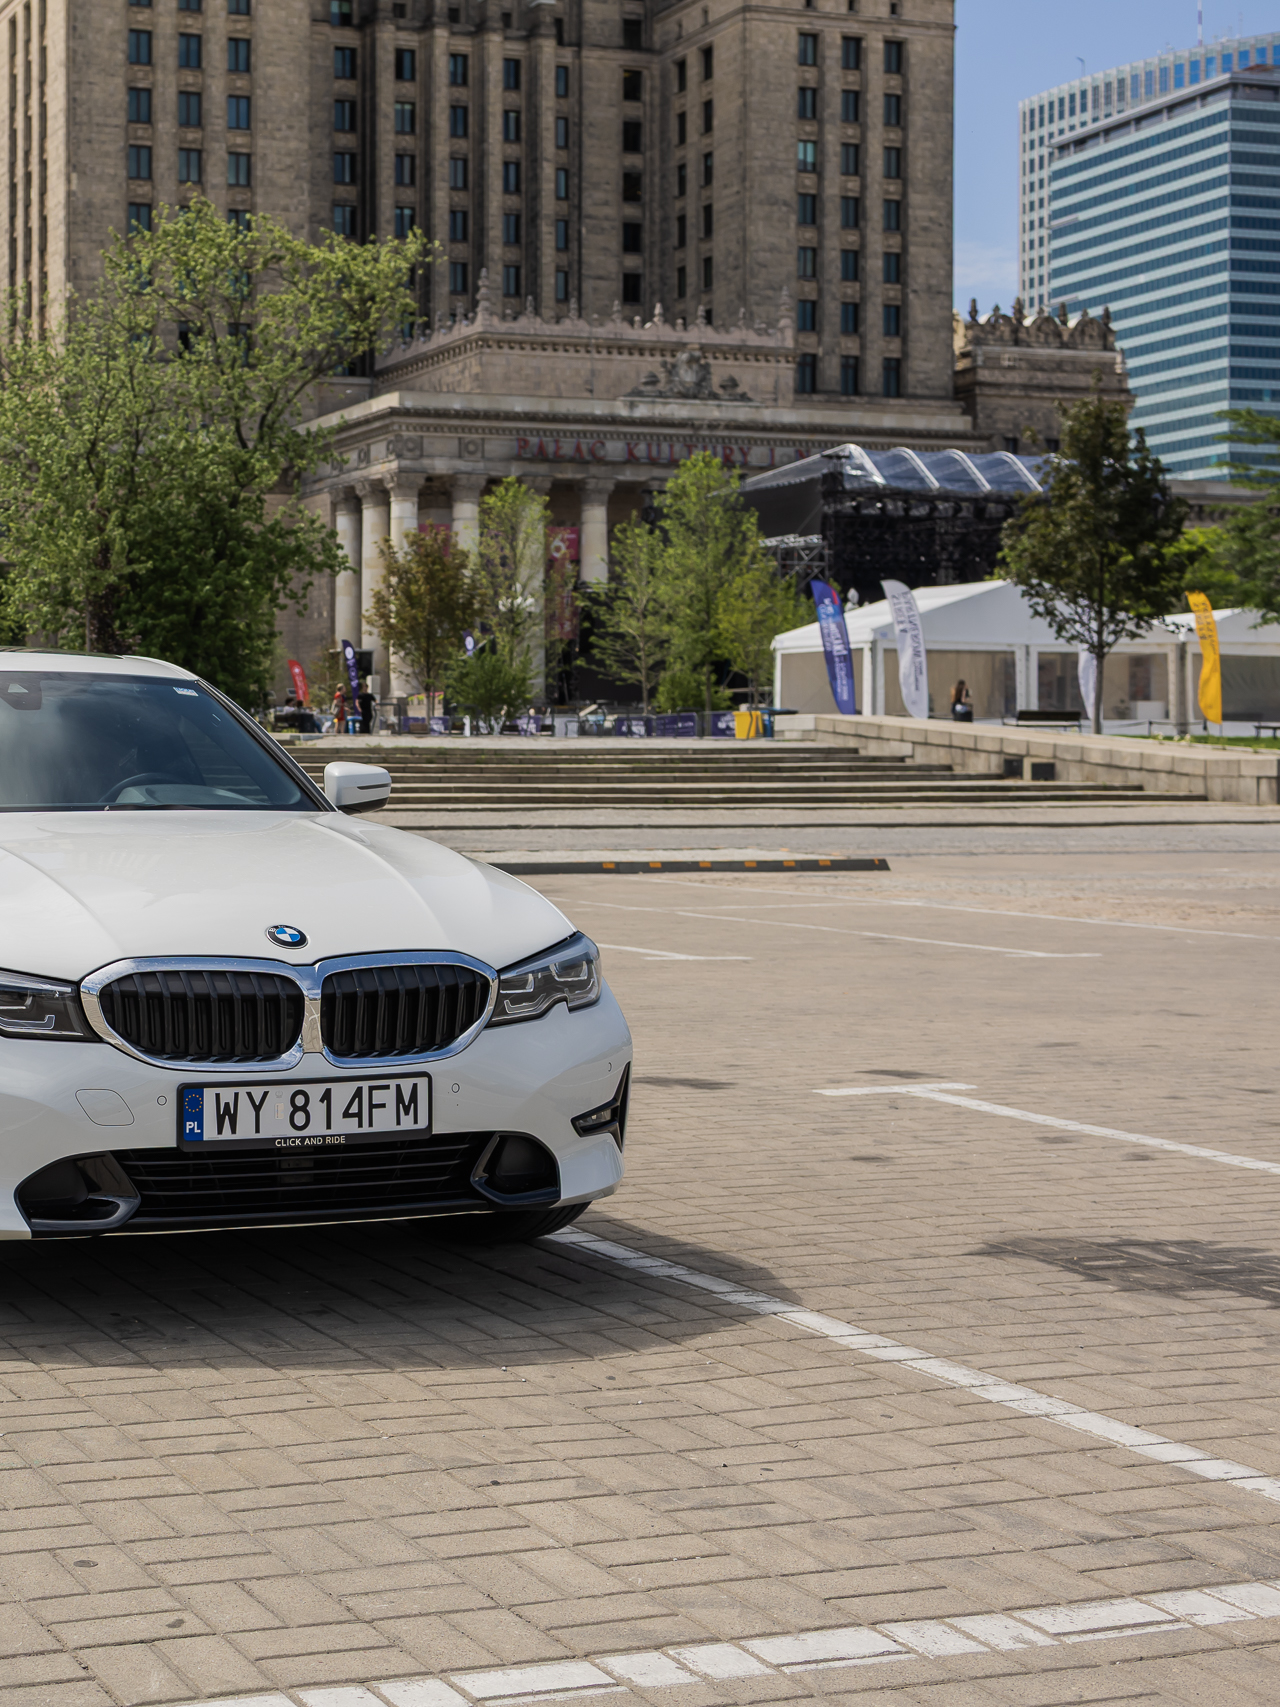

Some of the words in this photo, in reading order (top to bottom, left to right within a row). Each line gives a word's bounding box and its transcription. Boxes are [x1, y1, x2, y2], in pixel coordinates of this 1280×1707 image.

[516, 437, 606, 460] PAŁAC
[626, 441, 753, 466] KULTURY
[214, 1090, 270, 1135] WY
[288, 1082, 419, 1132] 814FM
[185, 1121, 201, 1134] PL
[275, 1138, 302, 1147] CLICK
[304, 1136, 323, 1146] AND
[325, 1135, 346, 1144] RIDE
